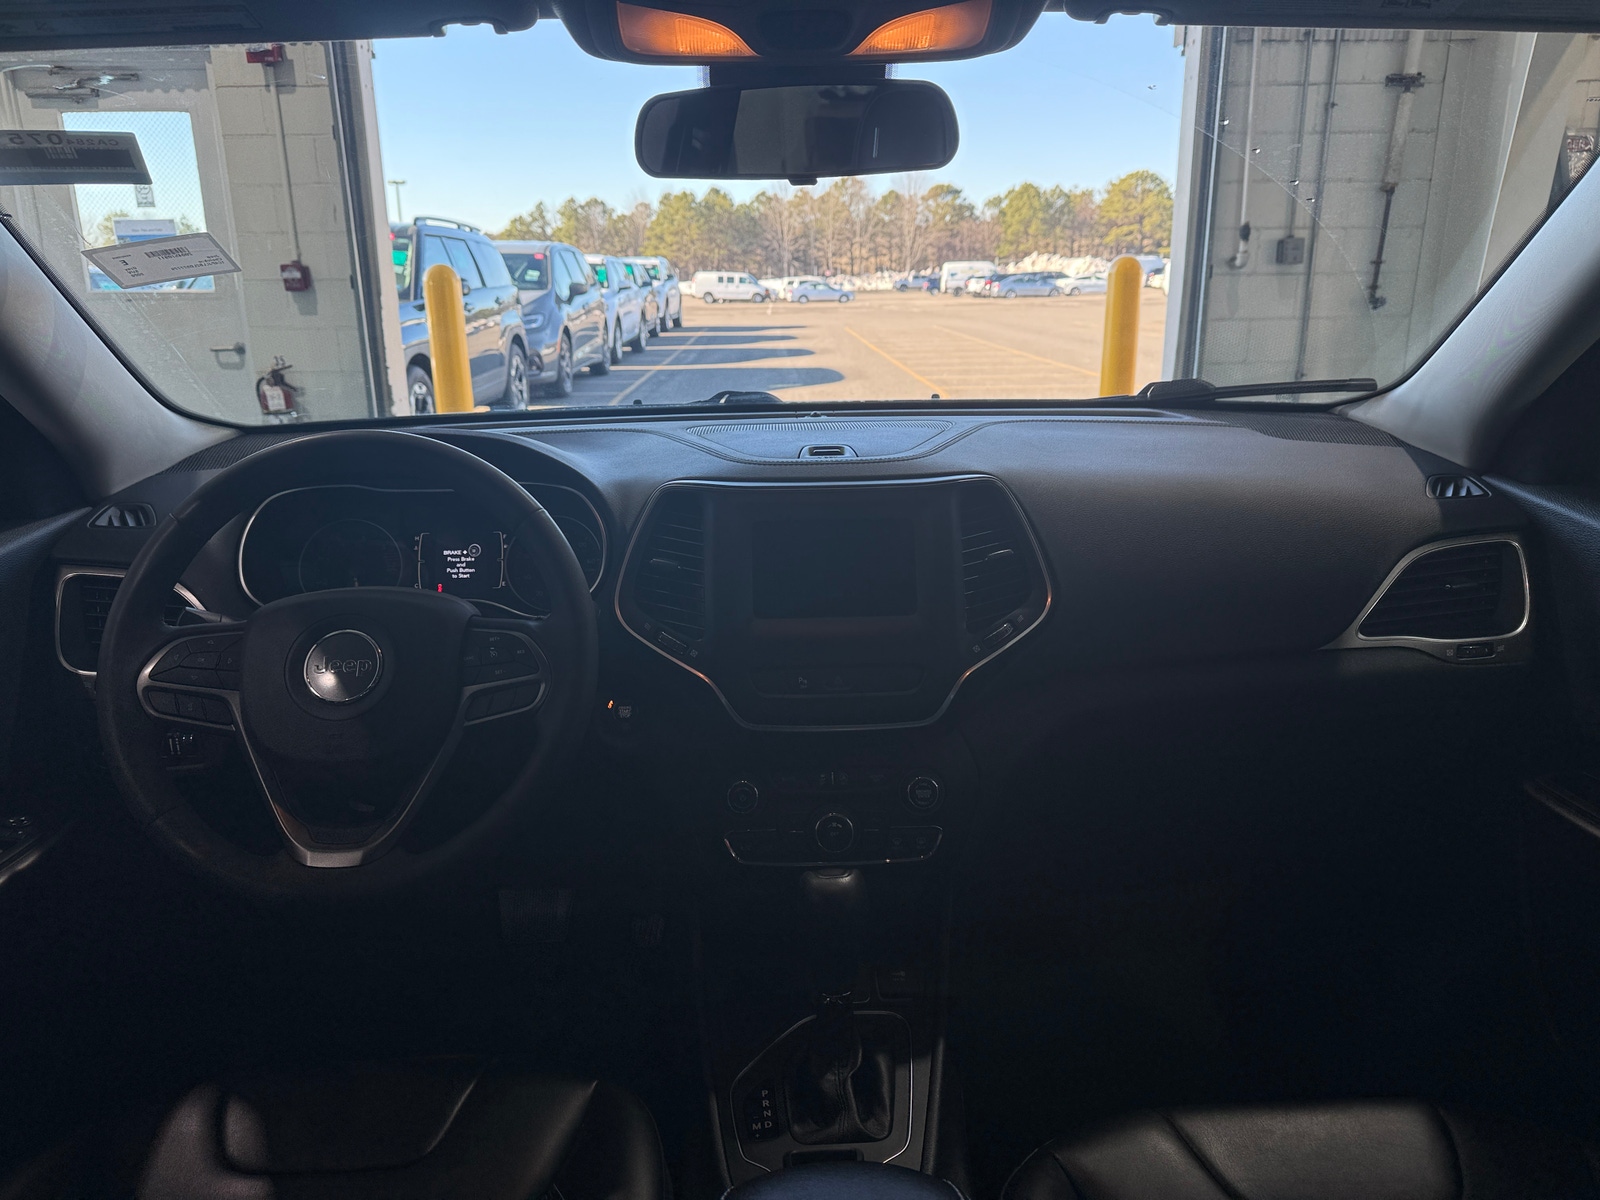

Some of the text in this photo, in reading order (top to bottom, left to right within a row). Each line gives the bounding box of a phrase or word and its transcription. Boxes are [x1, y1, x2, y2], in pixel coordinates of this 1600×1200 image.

[313, 655, 373, 678] Jeep
[762, 1089, 769, 1097] P
[762, 1099, 770, 1108] R
[763, 1109, 772, 1117] N
[752, 1122, 762, 1130] M
[764, 1120, 772, 1128] D
